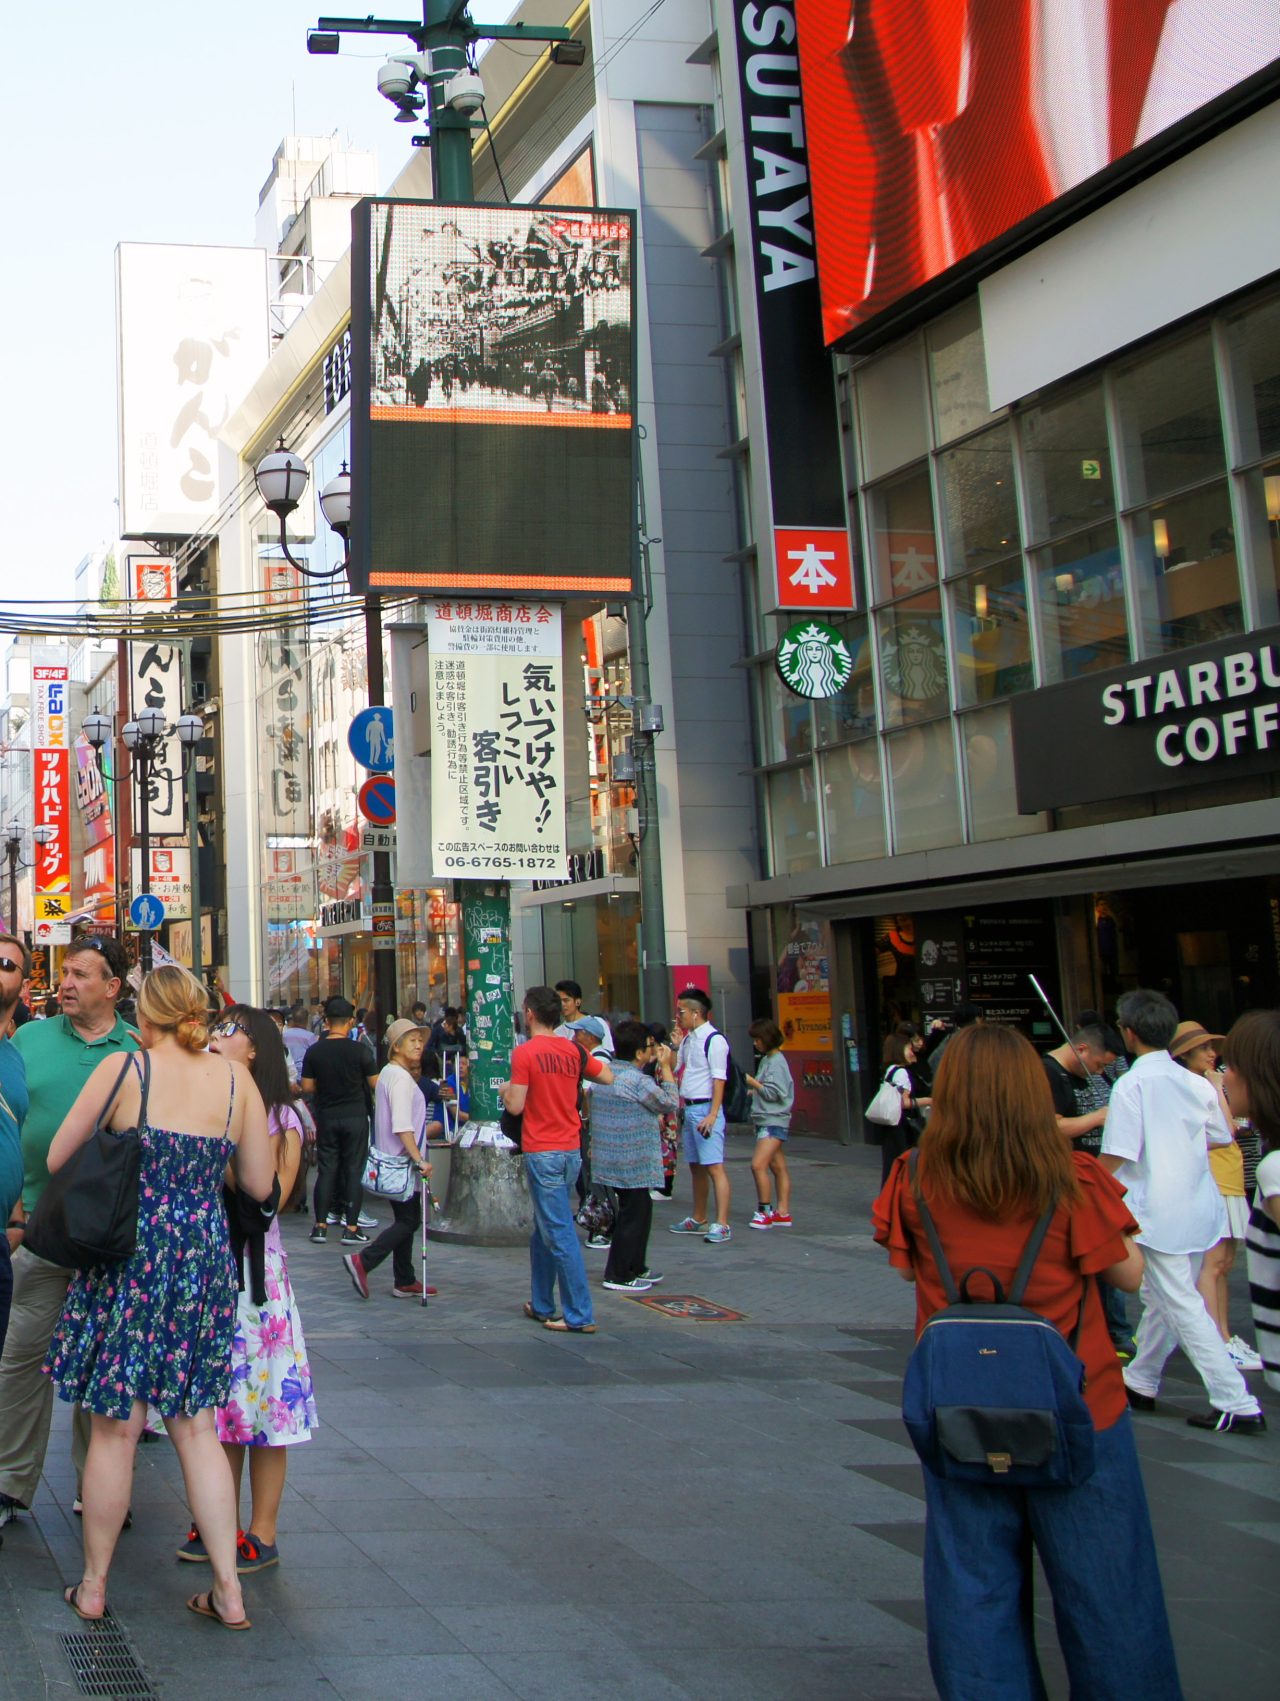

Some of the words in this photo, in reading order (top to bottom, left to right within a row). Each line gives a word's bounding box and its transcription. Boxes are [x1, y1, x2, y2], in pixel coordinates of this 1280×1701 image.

[787, 543, 837, 594] 本
[435, 603, 553, 623] 道頓堀商店会
[35, 668, 67, 679] 3F/4F
[434, 660, 445, 737] 注意しましょう。
[1156, 702, 1279, 767] COFF
[472, 730, 502, 832] 客引き
[40, 752, 62, 875] ツルハドラッグ
[438, 842, 560, 853] この広告スペースのお問い合わせは
[445, 857, 556, 868] 06-6765-1872
